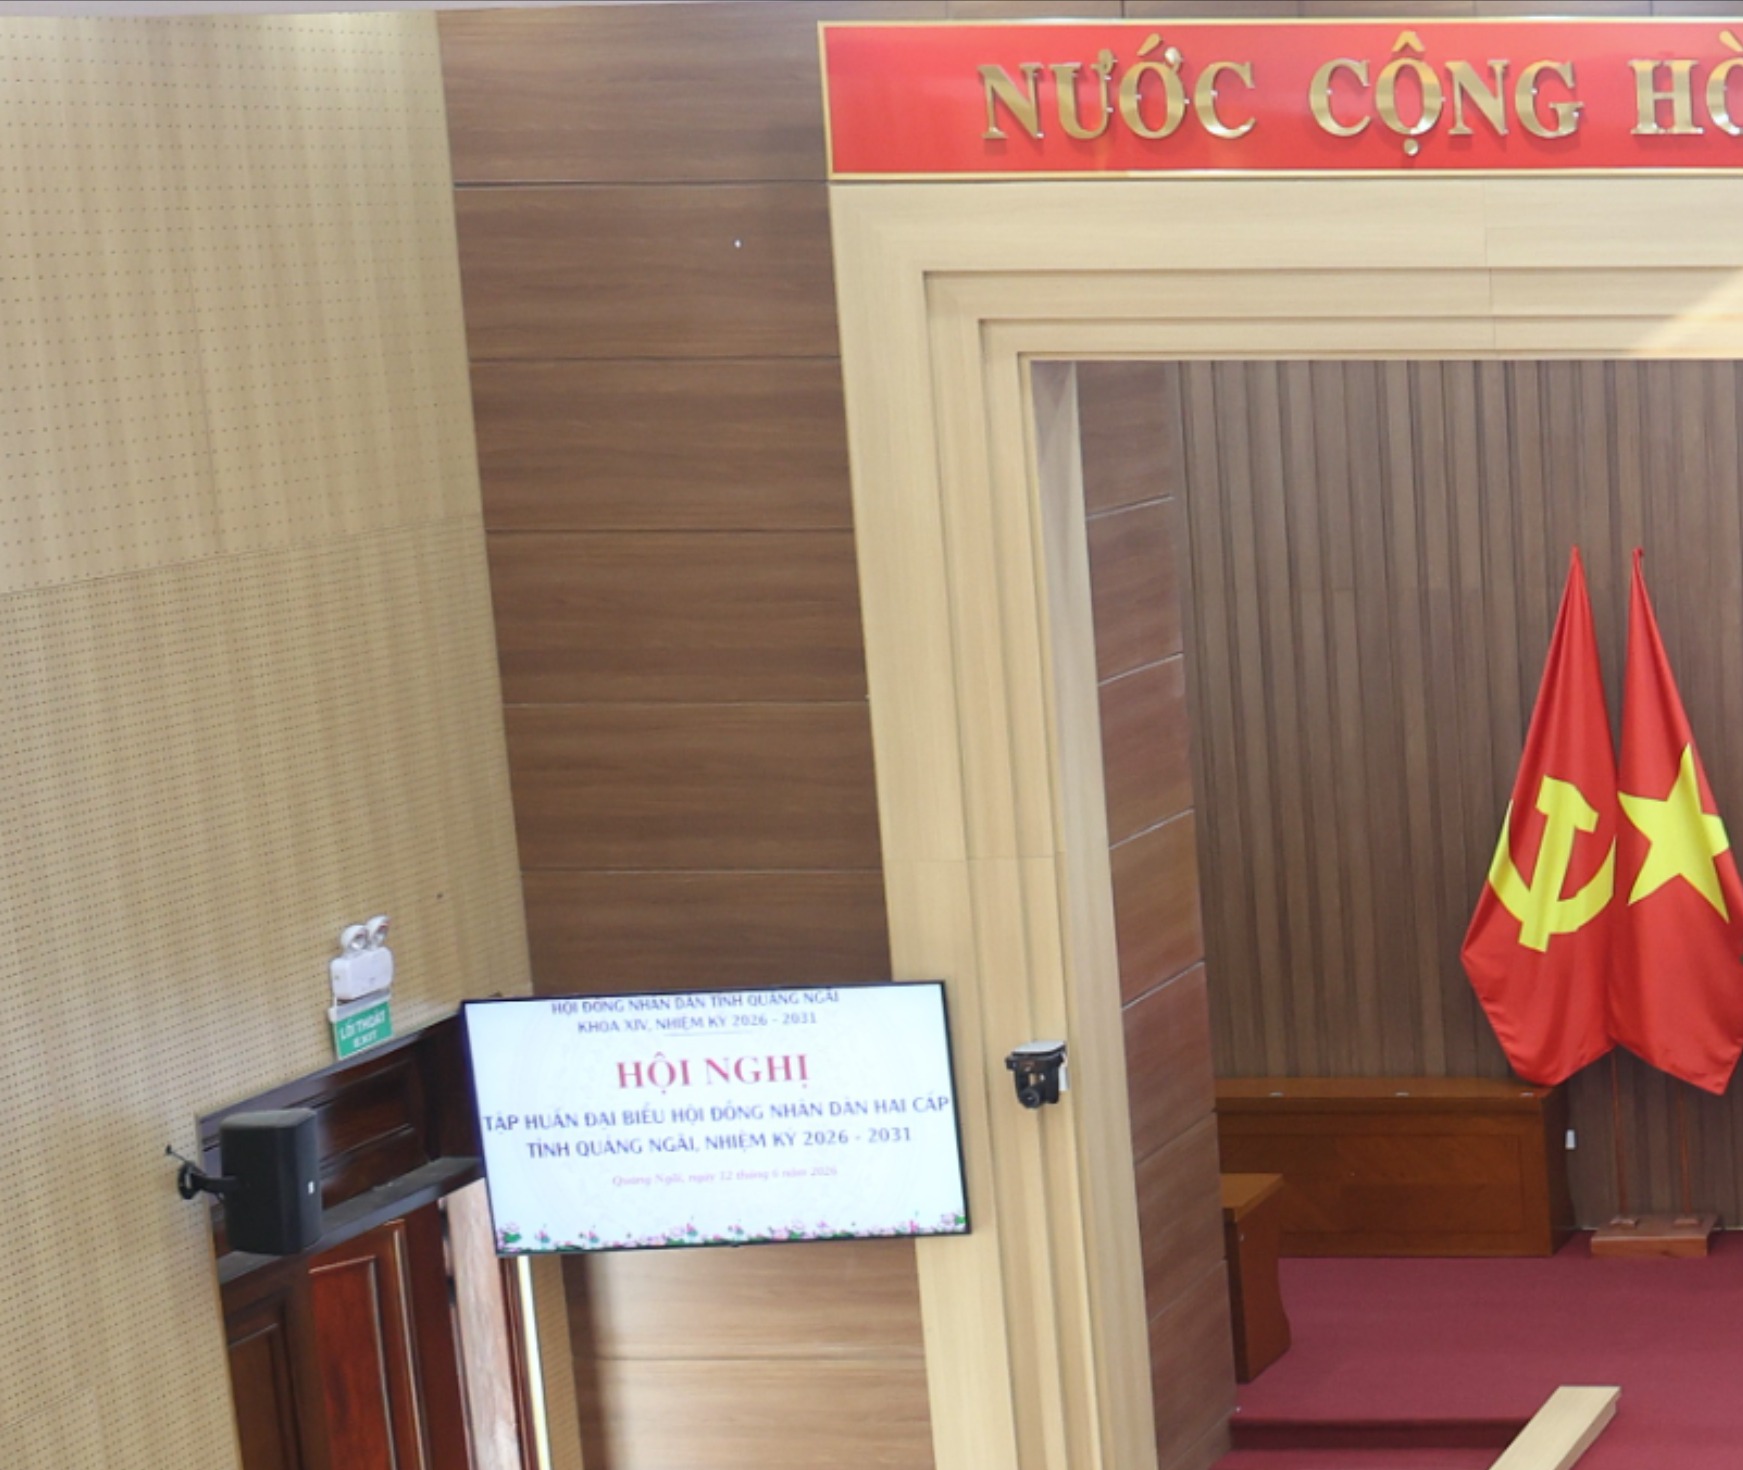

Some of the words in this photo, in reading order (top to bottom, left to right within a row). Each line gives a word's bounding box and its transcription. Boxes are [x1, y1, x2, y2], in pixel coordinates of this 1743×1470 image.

[980, 40, 1258, 143] NƯỚC
[1308, 31, 1581, 157] CỘNG
[616, 1052, 690, 1095] HỘI
[704, 1053, 808, 1089] NGHỊ
